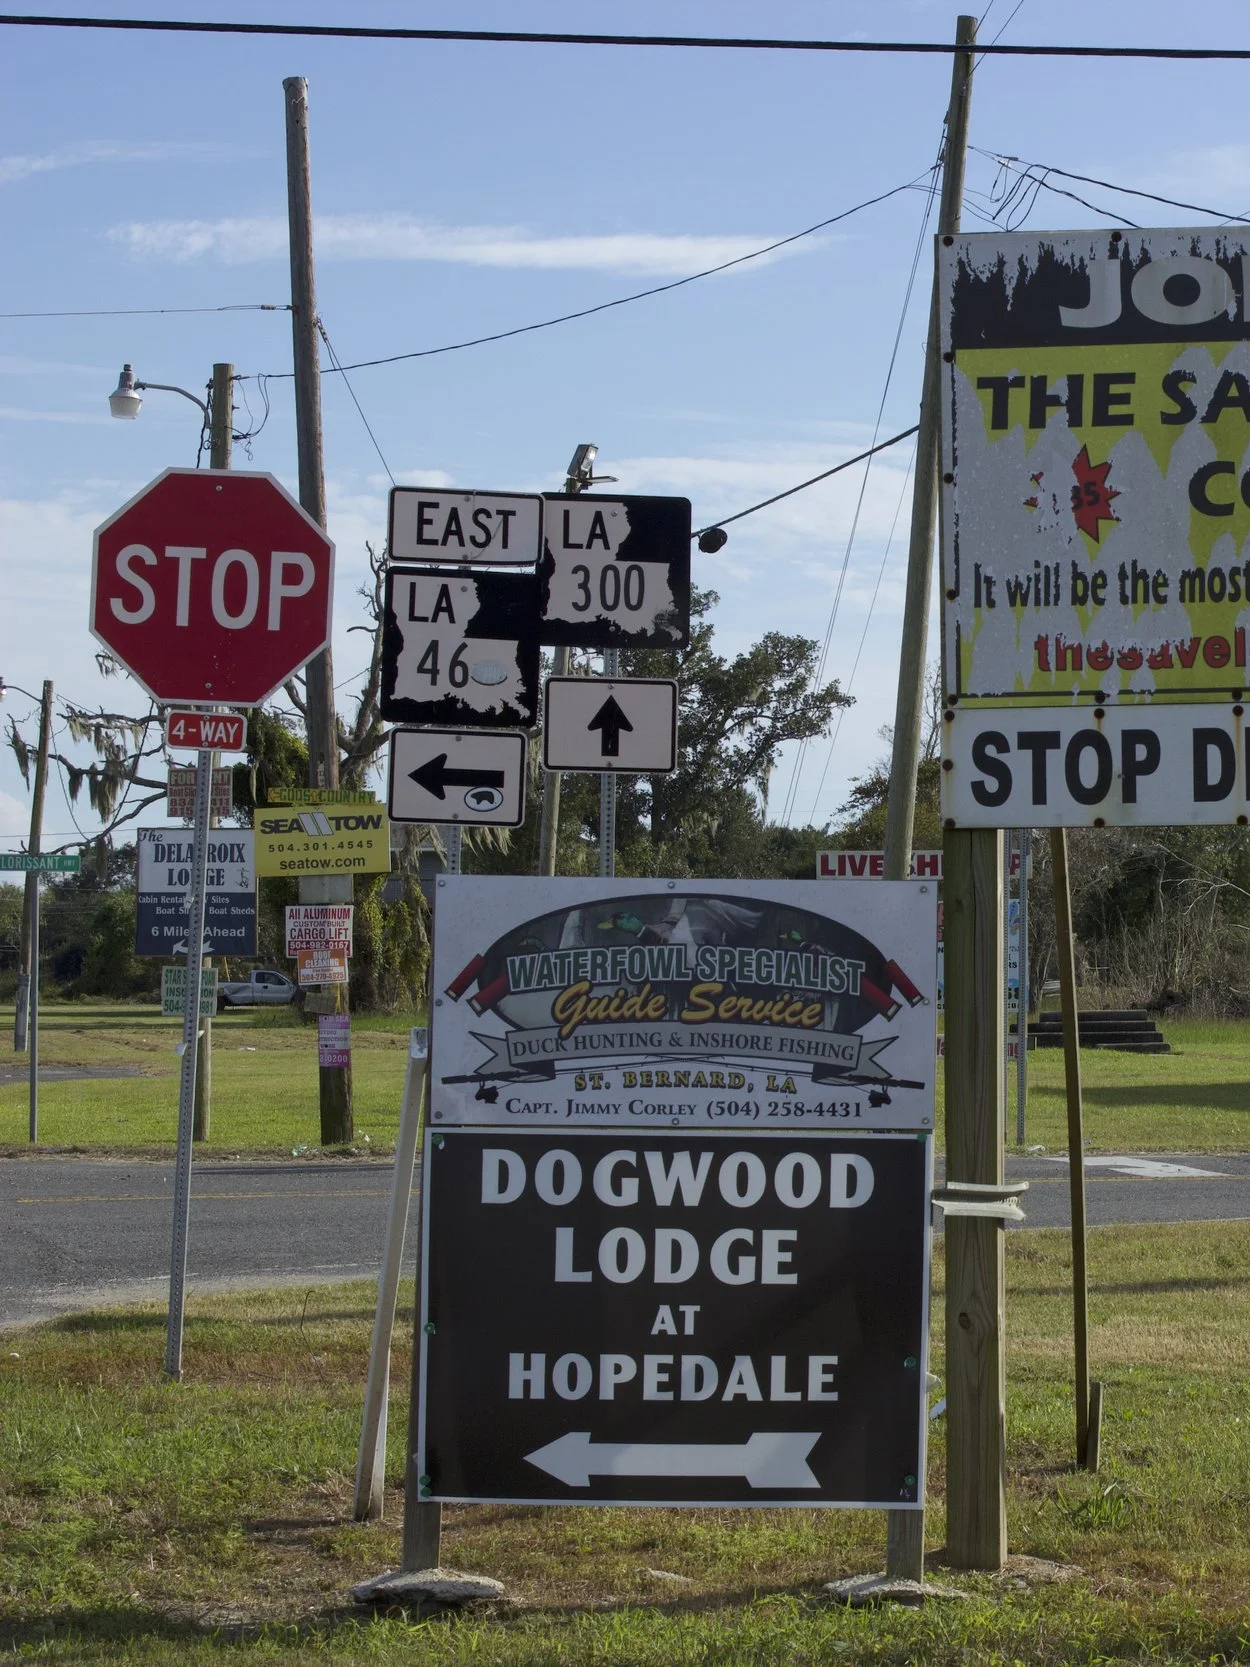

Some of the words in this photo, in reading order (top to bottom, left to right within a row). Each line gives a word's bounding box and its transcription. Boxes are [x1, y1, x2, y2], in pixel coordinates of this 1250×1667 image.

[976, 371, 1136, 430] THE
[416, 501, 516, 550] EAST
[563, 509, 610, 550] LA
[110, 544, 316, 631] STOP
[571, 564, 645, 612] 300
[973, 562, 996, 608] It
[1006, 560, 1060, 607] will
[1071, 560, 1108, 607] be
[1118, 558, 1168, 605] the
[408, 581, 455, 624] LA
[416, 640, 469, 688] 46
[172, 720, 239, 744] 4-WAY
[970, 729, 1161, 807] STOP
[319, 790, 373, 804] COUNTRY
[138, 829, 163, 842] The
[260, 818, 304, 834] SEA
[328, 815, 382, 831] TOW
[154, 843, 246, 863] DELAROIX
[269, 840, 373, 852] 504.301.4545
[280, 857, 366, 870] seatow.com
[820, 854, 884, 876] LIVE
[167, 868, 225, 887] LOGE
[156, 907, 175, 915] Boat
[209, 907, 227, 915] Boat
[231, 907, 255, 915] Sheds
[289, 908, 300, 919] All
[304, 908, 350, 919] ALUMINUM
[151, 927, 159, 936] 6
[164, 926, 190, 936] Mile
[203, 926, 245, 936] Ahead
[290, 928, 325, 940] CARGO
[329, 928, 349, 940] LIFT
[290, 941, 349, 949] 504-982-0167
[305, 958, 339, 968] CLEANING
[506, 944, 692, 992] WATERFOWL
[696, 946, 866, 996] SPECIALIST
[552, 980, 669, 1041] Guide
[680, 981, 824, 1030] Service
[513, 1038, 568, 1058] DUCK
[573, 1032, 663, 1052] HUNTING
[668, 1032, 684, 1048] &
[689, 1032, 774, 1051] INSHORE
[777, 1037, 855, 1061] FISHING
[575, 1073, 611, 1091] ST.
[623, 1071, 754, 1093] BERNARD,
[766, 1075, 797, 1094] LA
[565, 1099, 622, 1117] JIMMY
[628, 1099, 697, 1116] CORLEY
[706, 1100, 760, 1120] (504)
[767, 1101, 862, 1118] 258-4431
[481, 1148, 876, 1208] DOGWOOD
[554, 1226, 798, 1286] LODGE
[650, 1304, 700, 1335] AT
[508, 1352, 839, 1402] HOPEDALE
